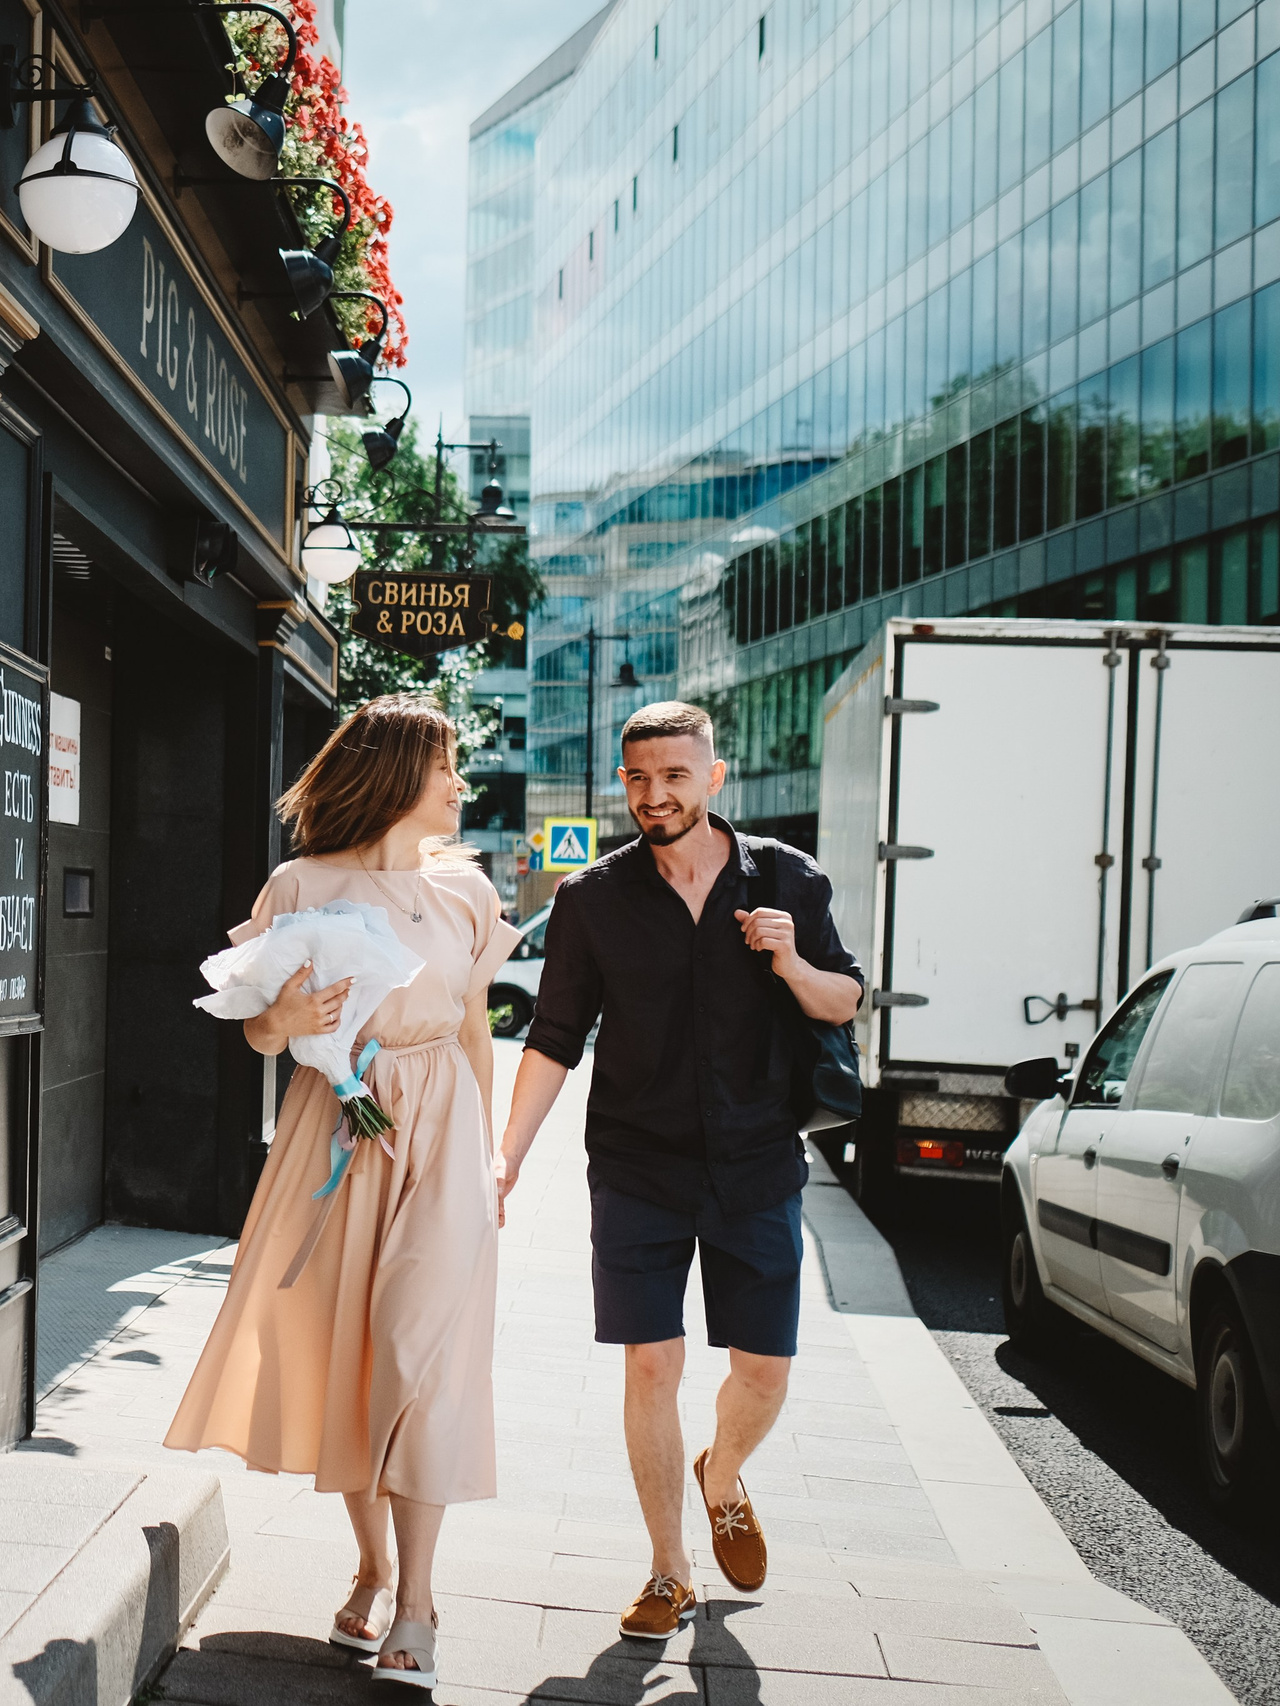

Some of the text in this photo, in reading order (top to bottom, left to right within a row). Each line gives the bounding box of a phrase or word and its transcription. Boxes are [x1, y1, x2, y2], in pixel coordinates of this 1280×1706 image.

[140, 235, 248, 485] PIG & ROSE
[367, 580, 471, 608] СВИНЬЯ
[376, 610, 466, 636] & РОЗА
[4, 769, 35, 823] ЕСТЬ
[15, 837, 24, 881] И
